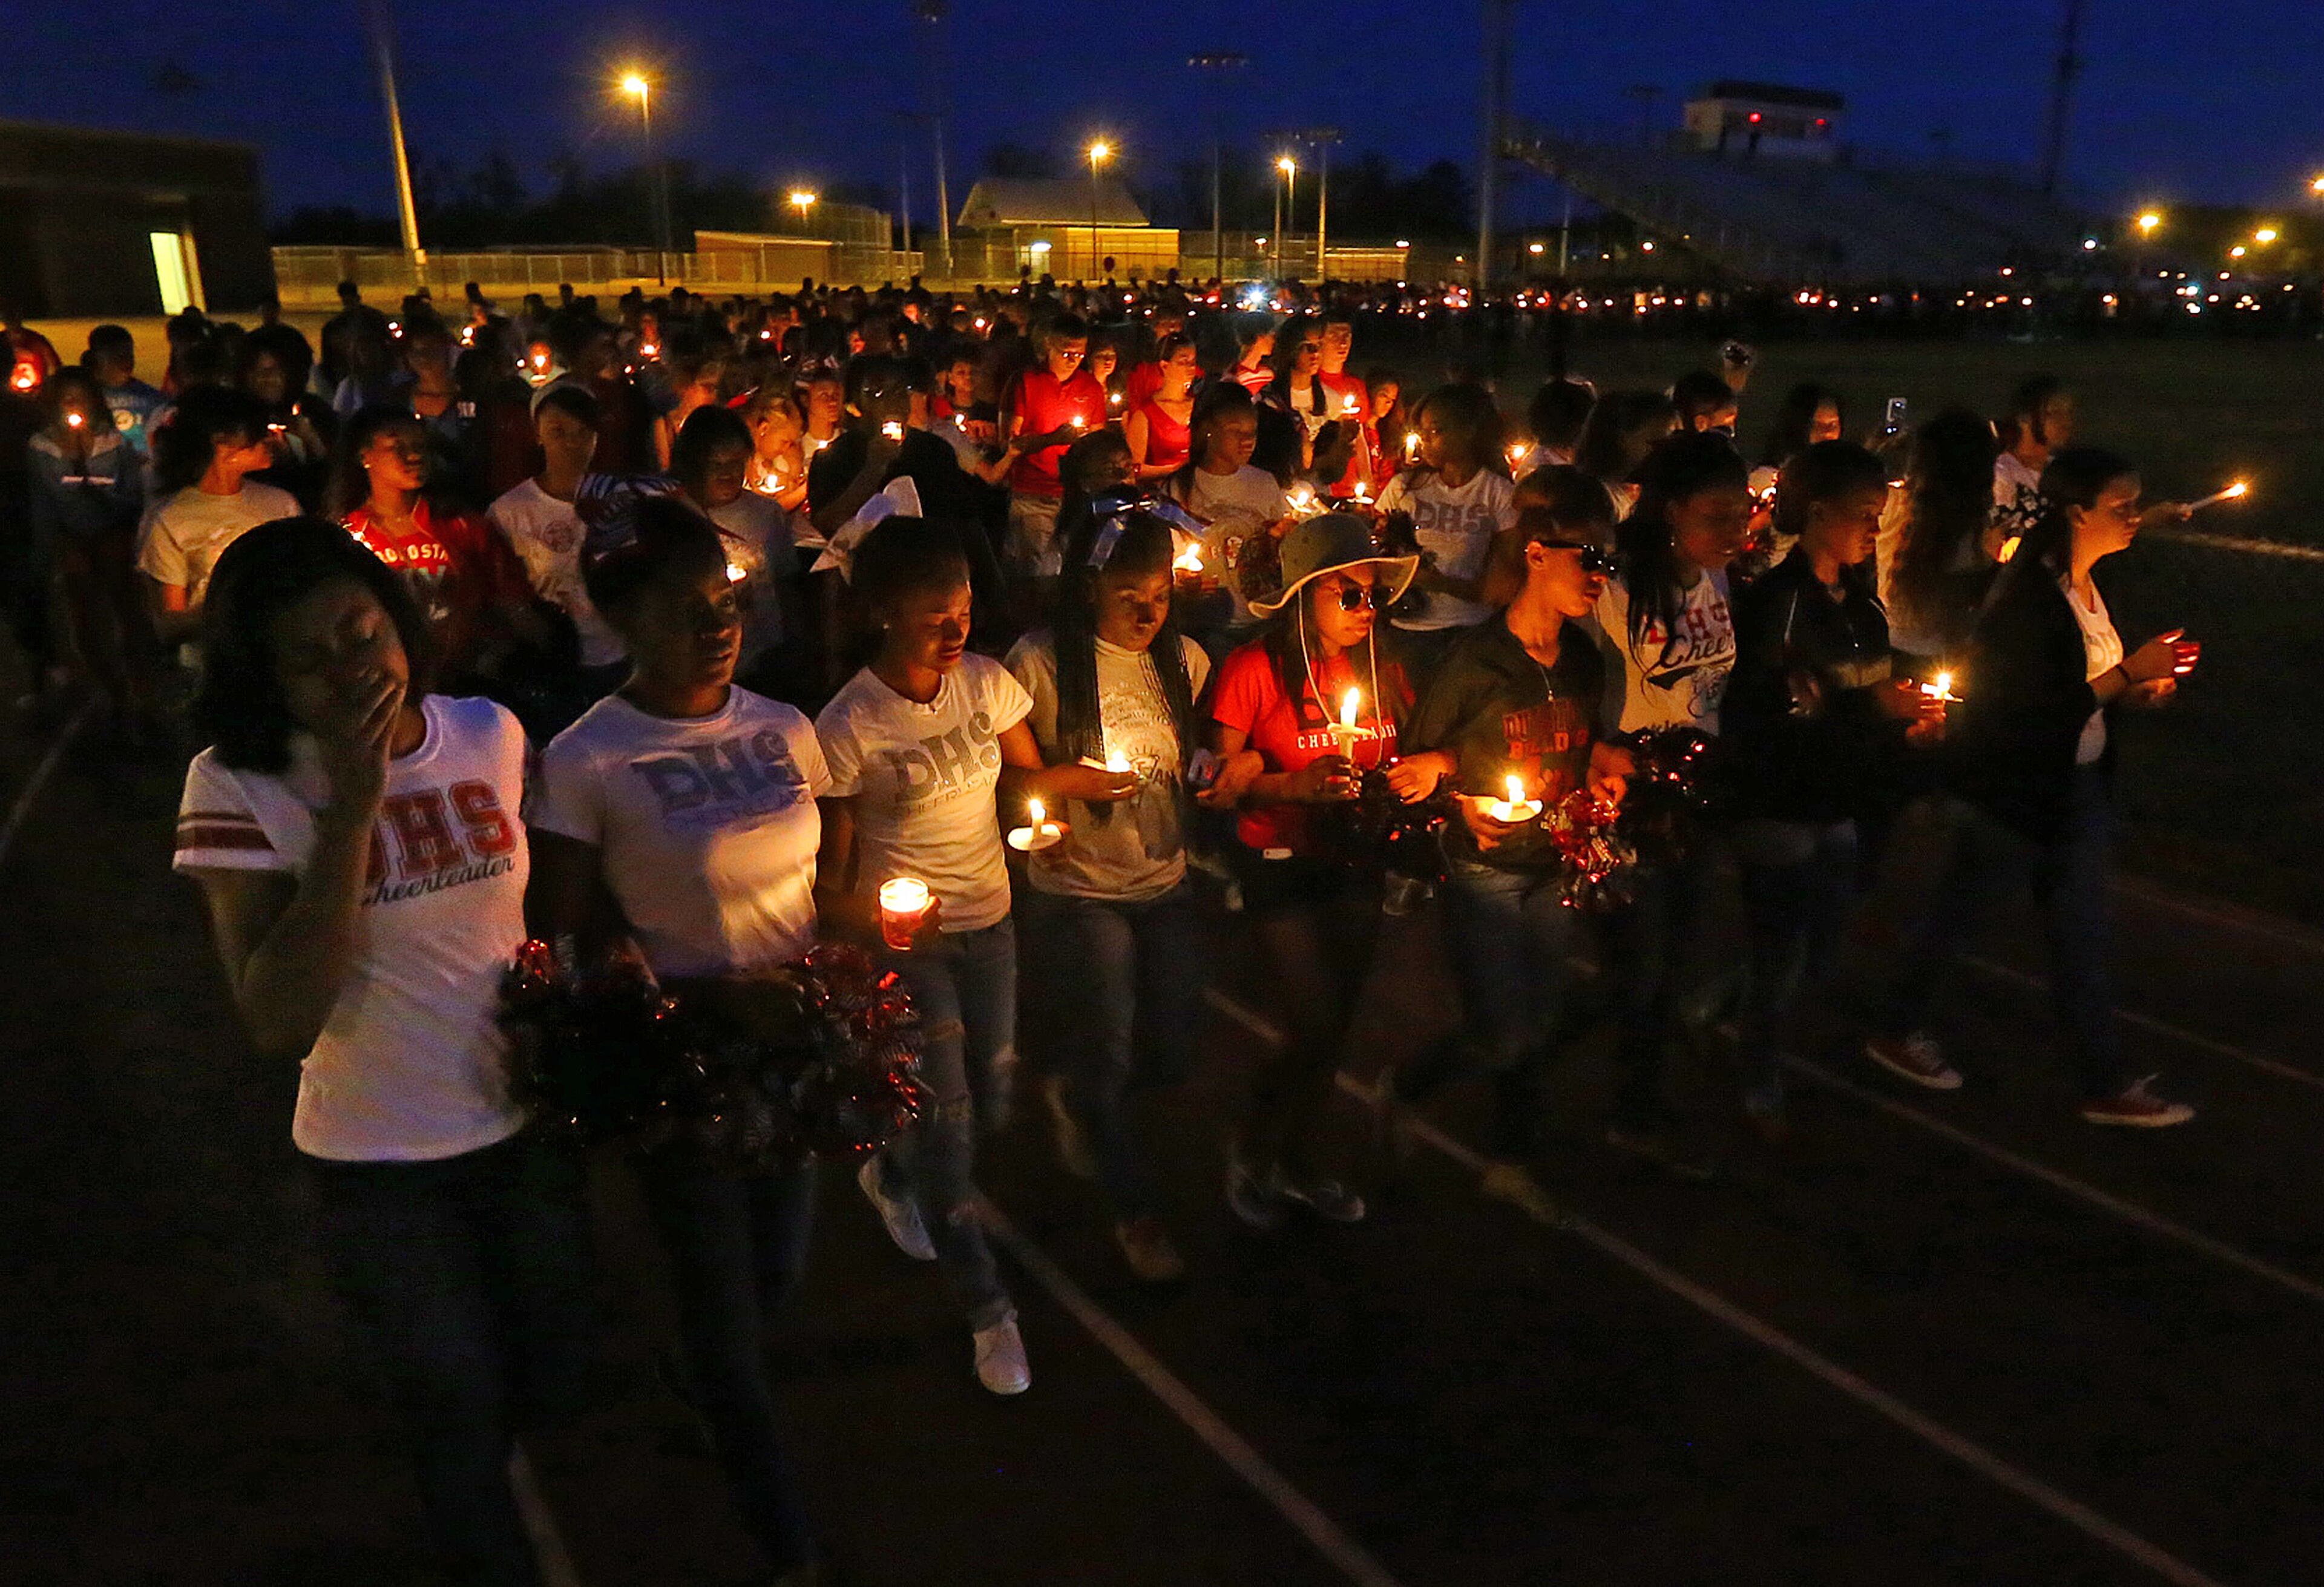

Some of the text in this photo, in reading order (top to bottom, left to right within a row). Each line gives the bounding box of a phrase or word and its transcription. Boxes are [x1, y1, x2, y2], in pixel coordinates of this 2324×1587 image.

[883, 711, 999, 803] DHS
[366, 780, 516, 884] HS
[362, 856, 515, 908] heerleader
